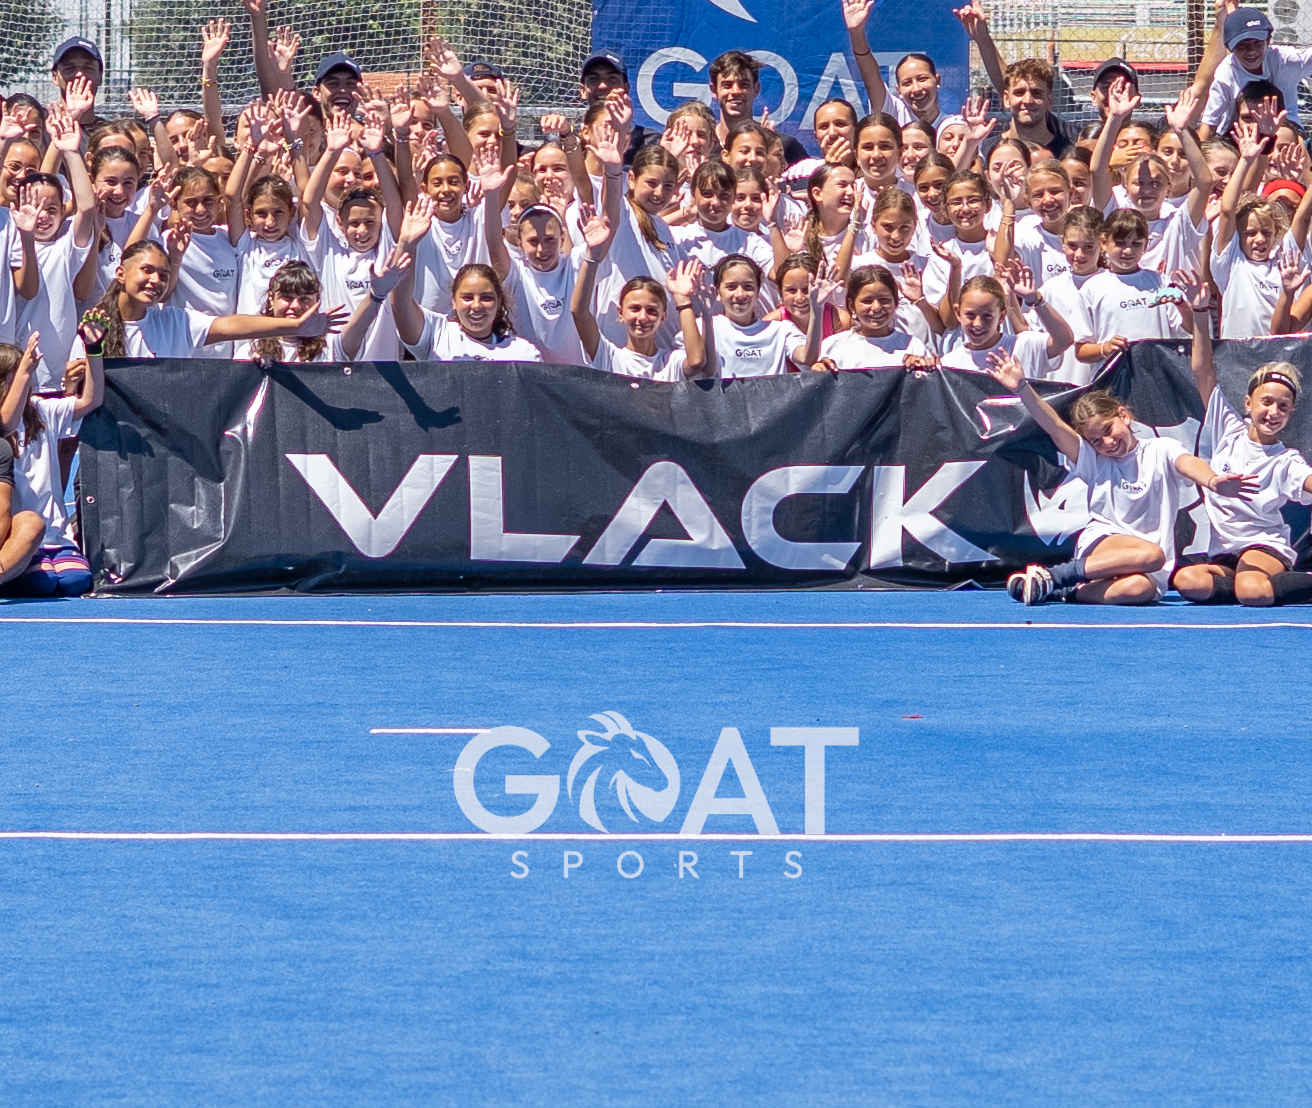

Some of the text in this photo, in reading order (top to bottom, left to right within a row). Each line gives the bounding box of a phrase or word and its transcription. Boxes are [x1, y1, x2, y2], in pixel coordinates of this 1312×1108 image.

[213, 269, 235, 278] GOAT
[1119, 297, 1147, 308] GOAT
[735, 349, 762, 357] GOAT
[285, 452, 999, 570] VLACK
